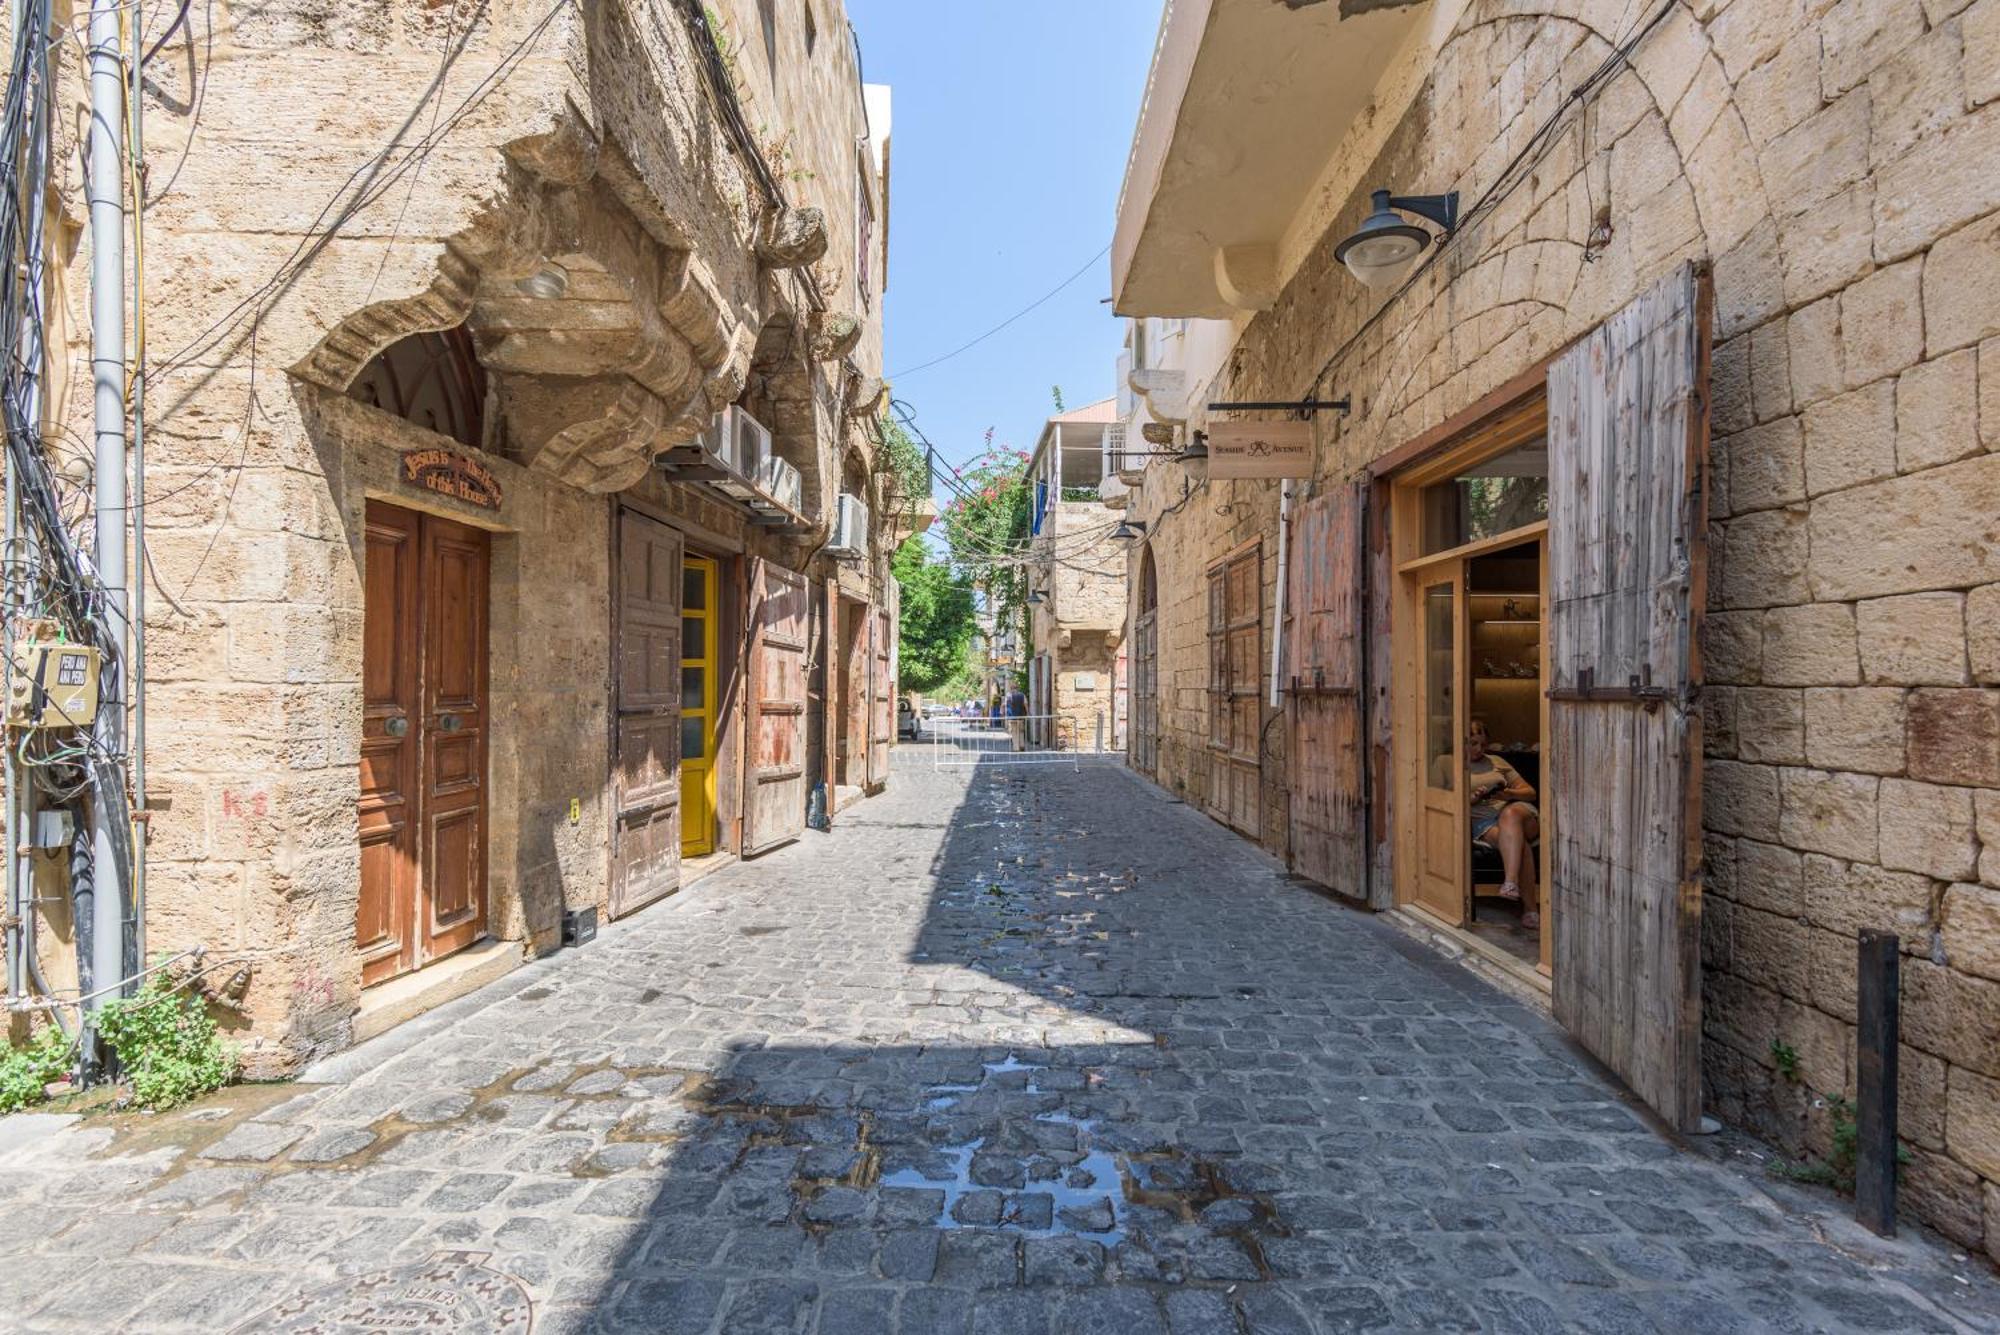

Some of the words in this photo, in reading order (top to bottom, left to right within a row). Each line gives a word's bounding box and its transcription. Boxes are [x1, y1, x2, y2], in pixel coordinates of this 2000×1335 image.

[1272, 444, 1304, 454] AVENUE
[404, 451, 440, 480] Jesus
[460, 481, 488, 506] House
